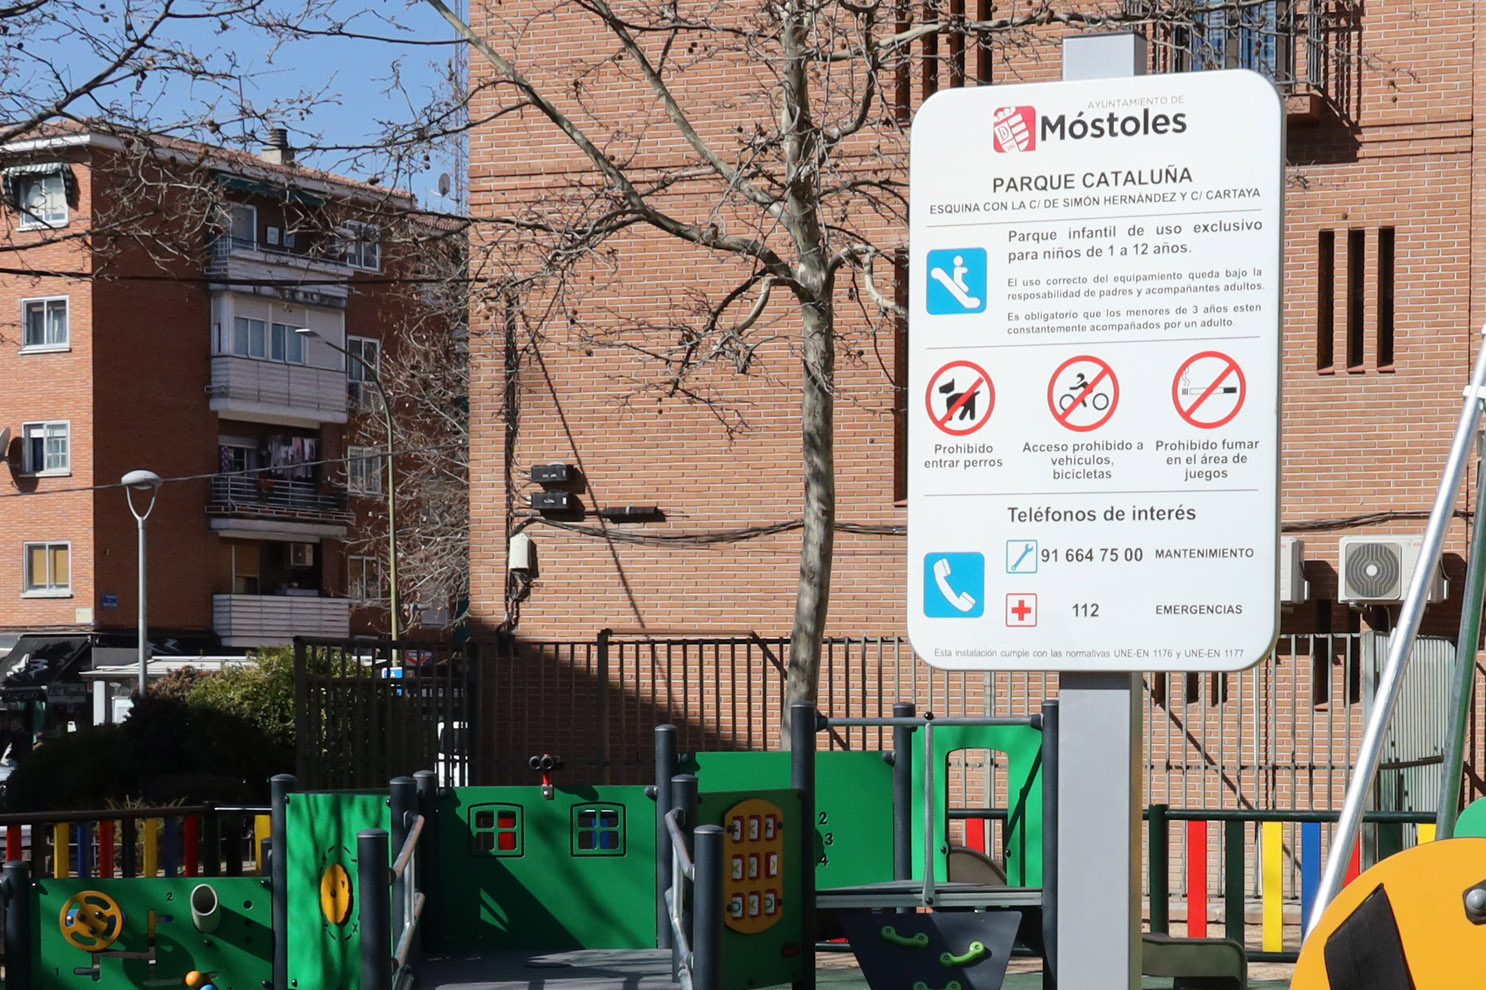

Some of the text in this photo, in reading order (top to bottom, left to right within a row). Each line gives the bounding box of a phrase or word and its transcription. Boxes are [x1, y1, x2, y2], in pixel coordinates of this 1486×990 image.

[1088, 95, 1184, 109] AYUNTAMIENTO DE
[1041, 108, 1187, 141] Móstoles
[993, 164, 1192, 193] PARQUE CATALUÑA
[930, 188, 1260, 214] ESQUINA CON LA C/ DE SIMÓN HERNÁNDEZ Y C/ CARTAYA
[1009, 219, 1262, 244] Parque infantil de uso exclusivo
[1009, 242, 1191, 264] para niños de 1 a 12 años.
[1008, 278, 1017, 287] El
[1046, 276, 1087, 285] correcto
[1093, 275, 1108, 283] del
[1114, 272, 1182, 284] equipamiento
[1188, 270, 1219, 280] queda
[1226, 269, 1247, 279] bajo
[1253, 268, 1262, 276] la
[1008, 289, 1080, 301] resposabilidad
[1084, 289, 1095, 297] de
[1099, 288, 1133, 298] padres
[1146, 285, 1220, 295] acompañantes
[1224, 282, 1264, 291] adultos.
[1008, 313, 1019, 321] Es
[1025, 311, 1078, 322] obligatorio
[1083, 311, 1101, 320] que
[1107, 309, 1121, 317] los
[1175, 306, 1187, 314] de
[1193, 305, 1198, 313] 3
[1203, 305, 1228, 313] años
[1008, 324, 1086, 334] constantemente
[1090, 321, 1160, 332] acompañados
[1164, 322, 1181, 330] por
[935, 443, 993, 454] Prohibido
[1023, 440, 1143, 454] Acceso prohibido a
[1156, 439, 1259, 451] Prohibido fumar
[924, 459, 1003, 470] entrar perros
[1051, 455, 1113, 466] vehículos,
[1167, 453, 1247, 465] en el área de
[1053, 469, 1111, 479] bicicletas
[1184, 468, 1228, 481] juegos
[1007, 504, 1196, 522] Teléfonos de interés
[1041, 548, 1254, 562] 91 664 75 00 MANTENIMIENTO
[1073, 603, 1242, 617] 112 EMERGENCIAS
[935, 648, 952, 656] Esta
[956, 648, 997, 657] instalación
[1001, 649, 1029, 659] cumple
[1051, 649, 1062, 657] las
[1114, 649, 1149, 657] UNE-EN
[1154, 649, 1172, 657] 1176
[1185, 649, 1220, 658] UNE-EN
[1225, 649, 1244, 657] 1177
[819, 812, 827, 825] 2
[825, 832, 834, 845] 3
[819, 854, 828, 866] 4
[166, 891, 173, 901] 2
